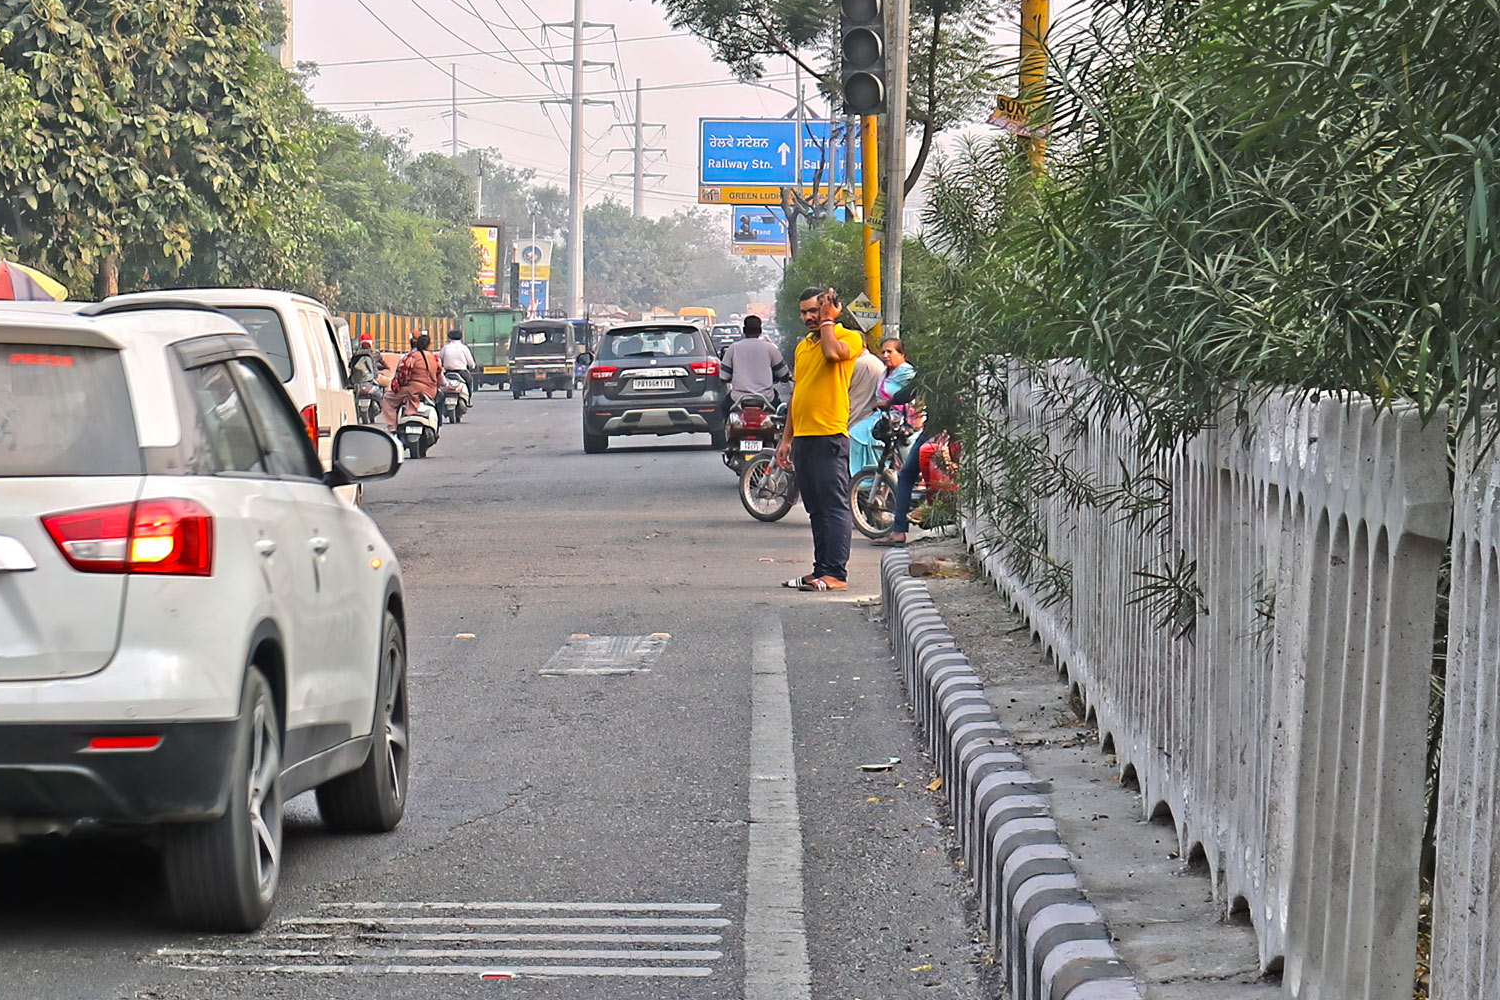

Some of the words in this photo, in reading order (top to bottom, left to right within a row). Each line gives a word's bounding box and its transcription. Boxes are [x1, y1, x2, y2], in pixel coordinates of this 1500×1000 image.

[708, 159, 750, 171] Railway
[751, 160, 773, 169] Stn.
[729, 192, 758, 200] GREEN
